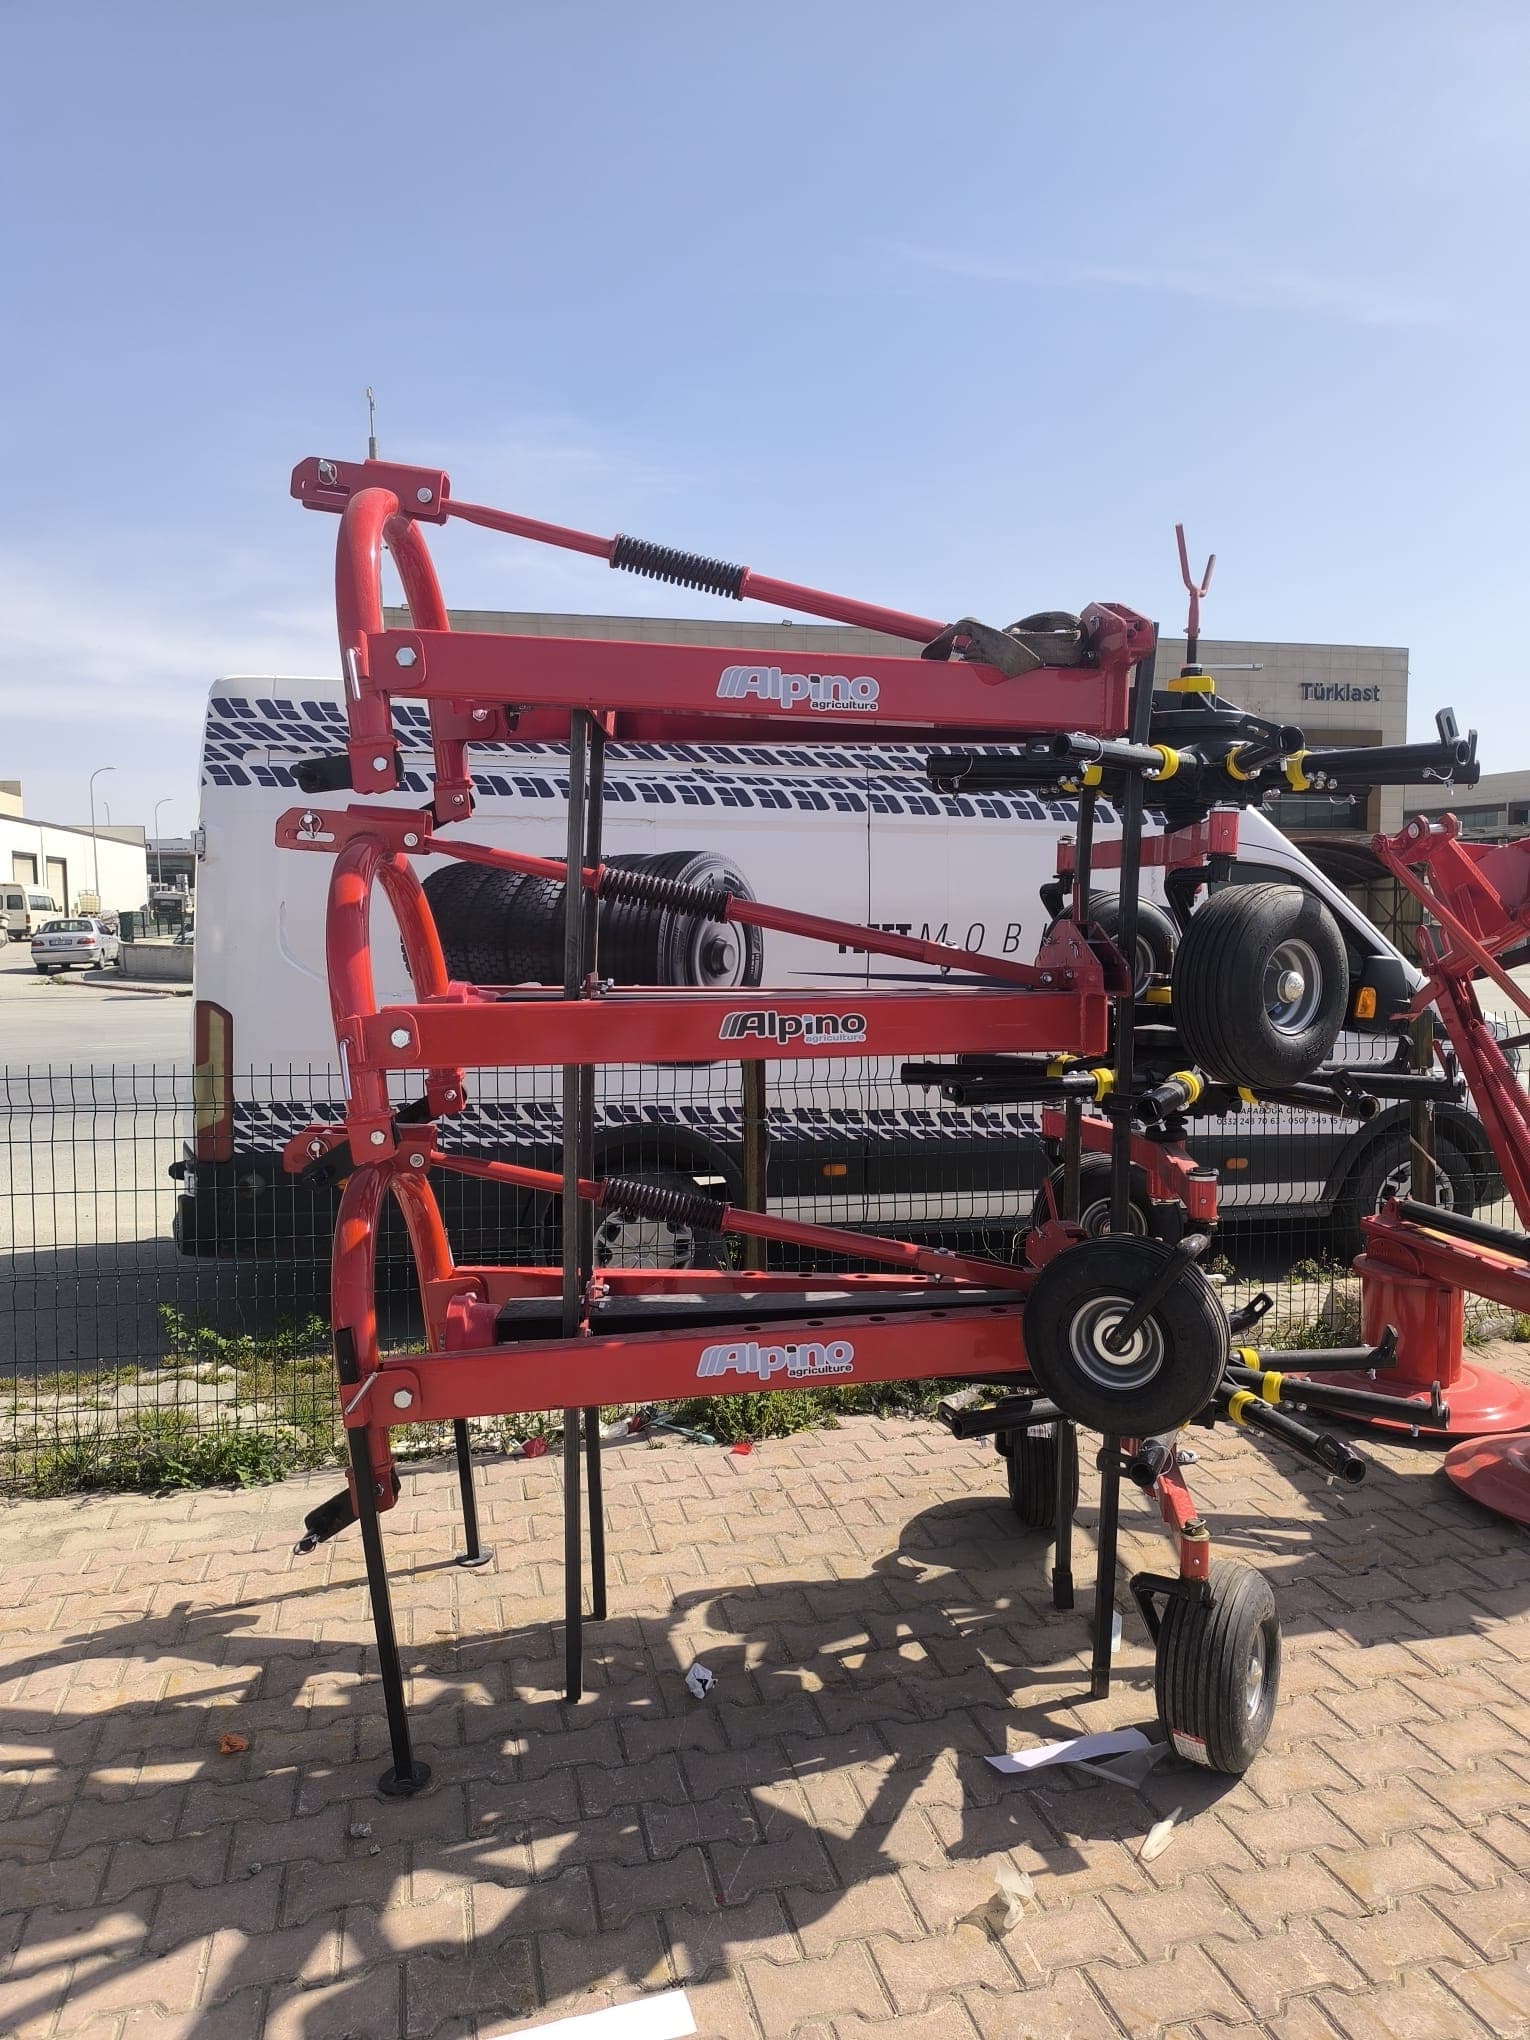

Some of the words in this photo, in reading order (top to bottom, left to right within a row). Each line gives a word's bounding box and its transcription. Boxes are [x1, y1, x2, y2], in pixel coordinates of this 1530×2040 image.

[717, 666, 879, 708] Alpino
[1300, 682, 1380, 702] Türklast
[811, 700, 878, 711] agriculture
[720, 1011, 867, 1043] Alpino
[805, 1033, 865, 1043] agriculture
[697, 1342, 853, 1379] Alpino
[788, 1363, 852, 1377] agriculture
